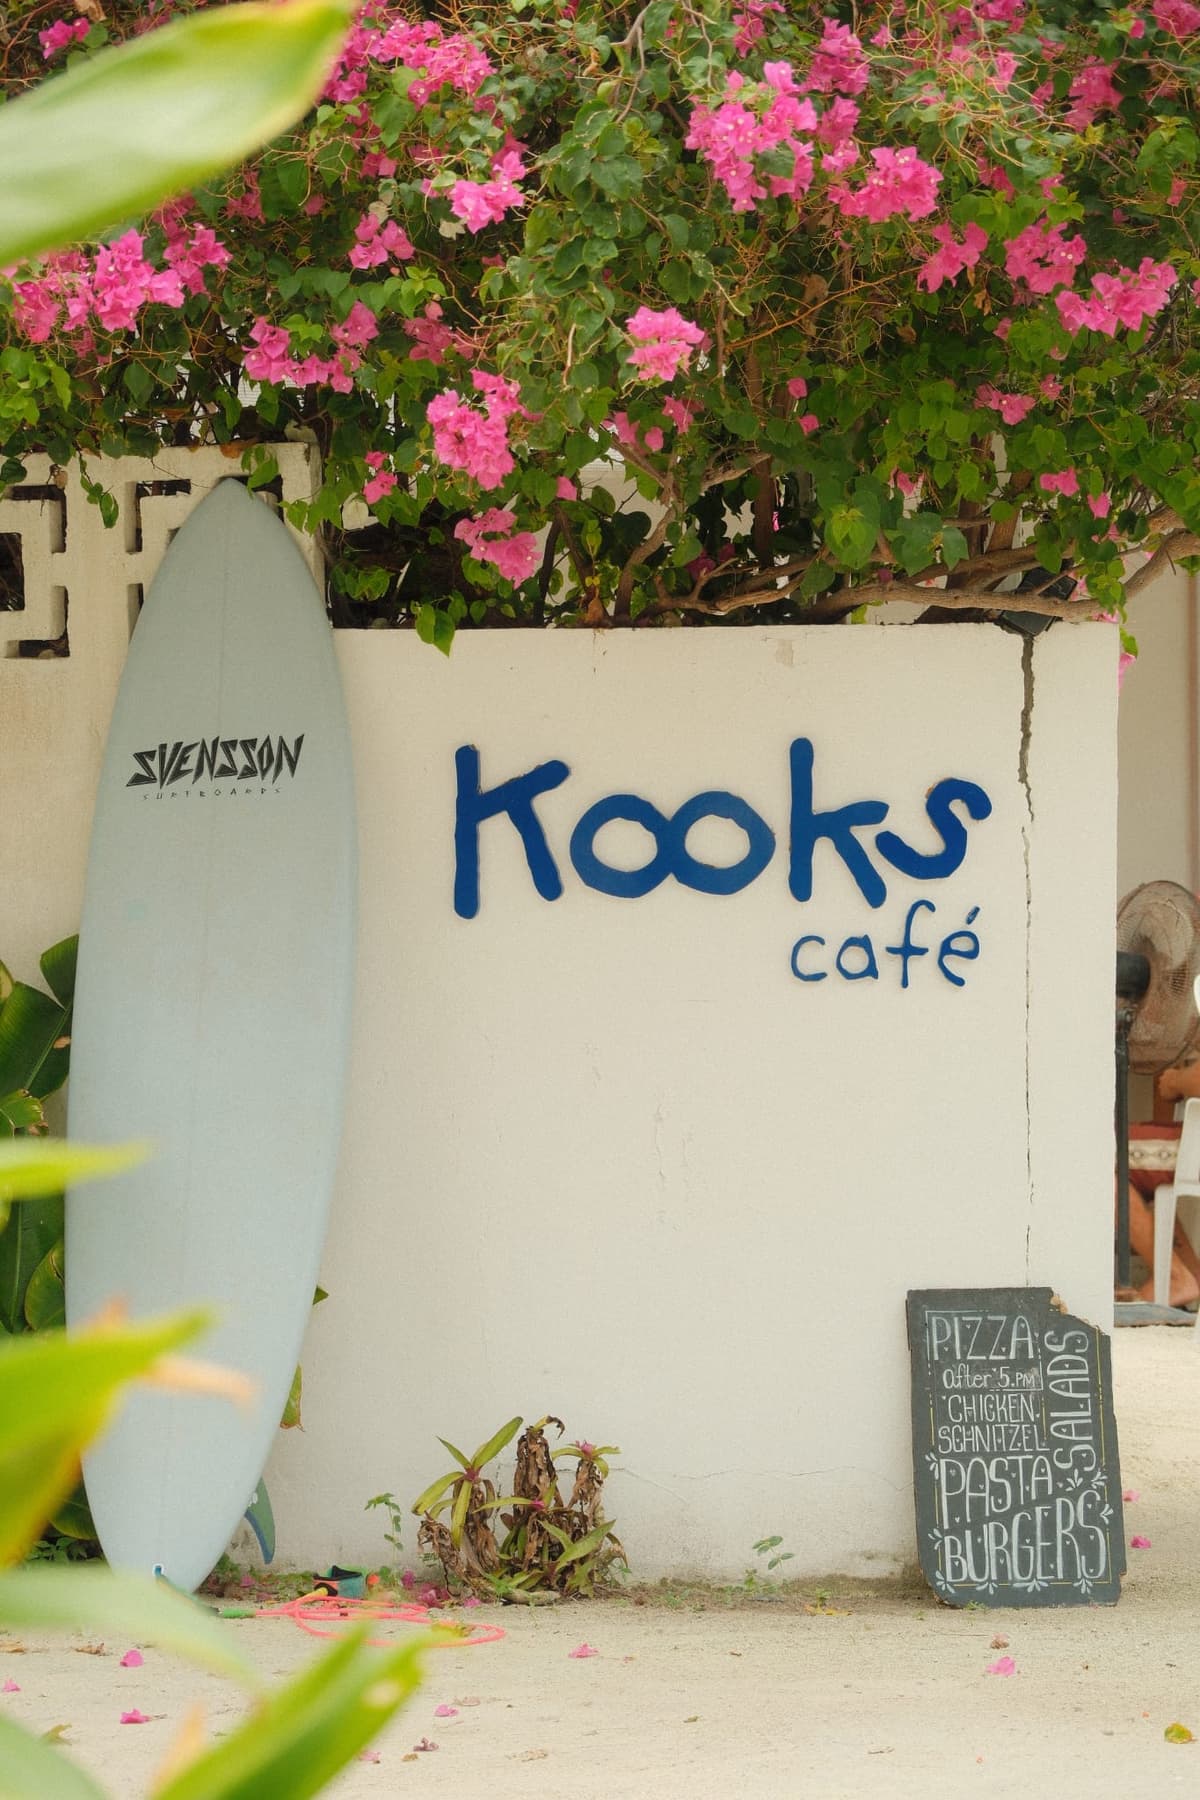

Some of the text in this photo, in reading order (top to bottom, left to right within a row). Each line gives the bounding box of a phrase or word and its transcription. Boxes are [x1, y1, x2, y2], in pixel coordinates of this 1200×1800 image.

[126, 734, 305, 790] SVENSSON
[454, 737, 992, 919] Kooks
[791, 900, 980, 988] café
[931, 1316, 1034, 1360] PIZZA
[942, 1363, 992, 1389] after
[948, 1393, 1036, 1423] CHICKEN
[1044, 1330, 1096, 1471] SALADS
[938, 1424, 1050, 1454] SCHNITZEL
[939, 1455, 1053, 1530] PASTA
[944, 1490, 1107, 1582] BURGERS
